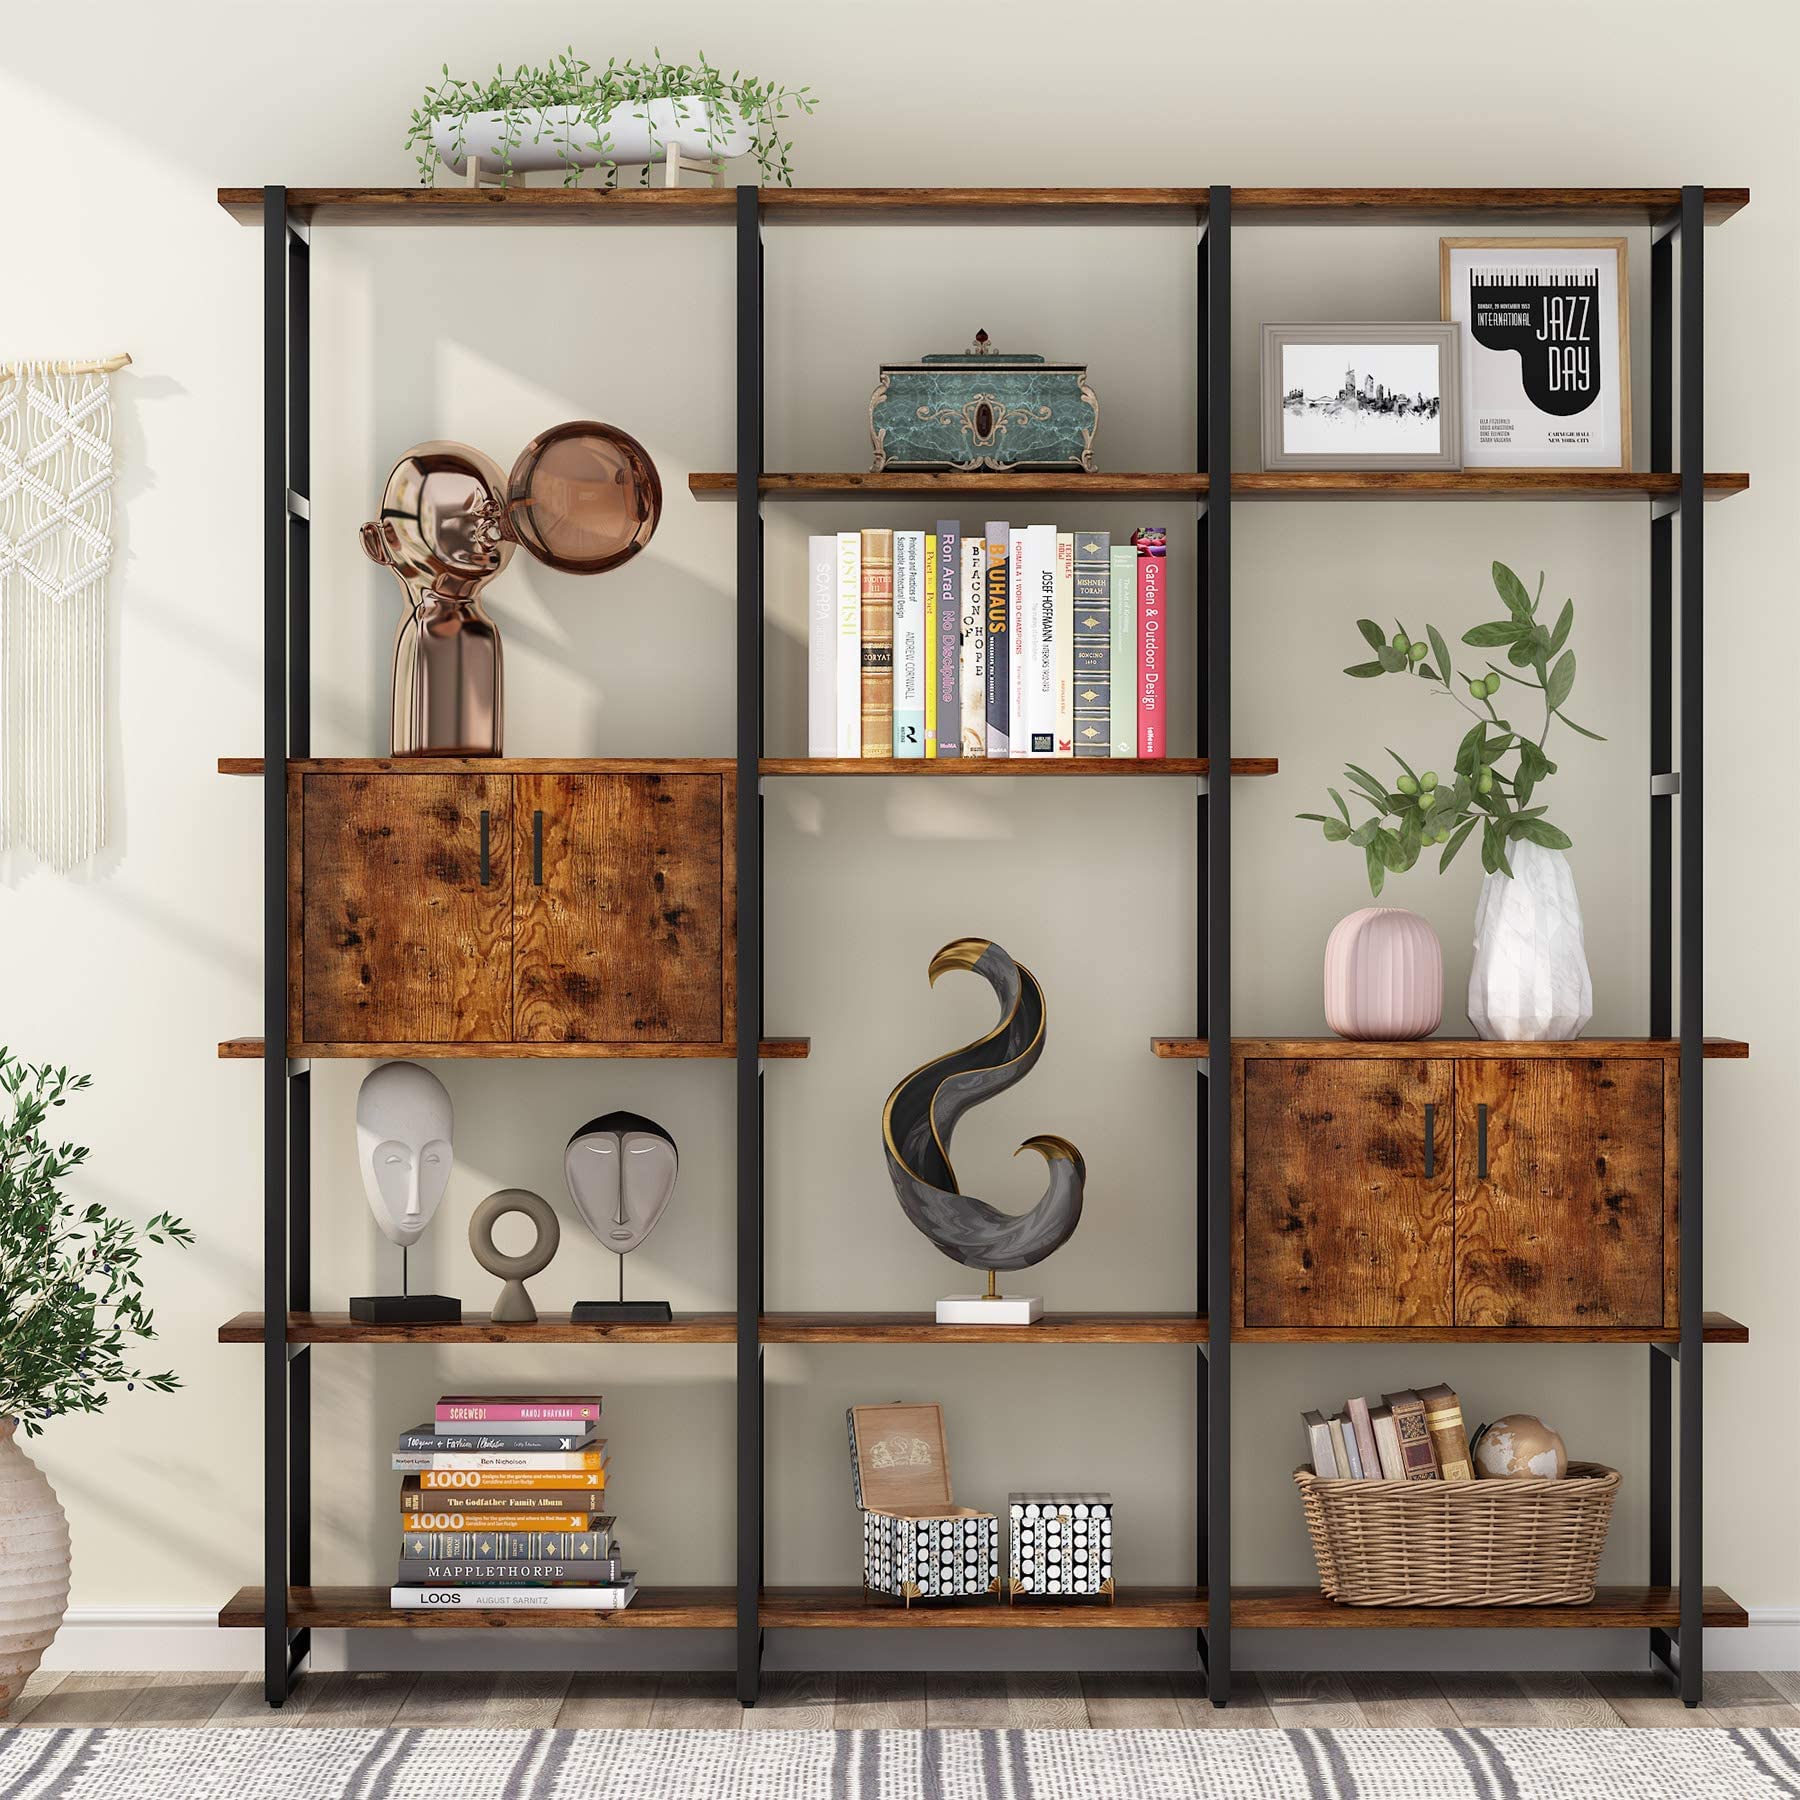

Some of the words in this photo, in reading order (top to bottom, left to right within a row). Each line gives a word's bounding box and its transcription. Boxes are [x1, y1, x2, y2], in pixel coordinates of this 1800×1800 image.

[1477, 312, 1531, 327] INTERNATIONAL
[1536, 296, 1591, 341] JAZZ
[1548, 346, 1590, 392] DAY
[897, 536, 906, 565] Sustainable
[942, 534, 955, 563] Ron
[841, 539, 858, 588] LOST
[908, 561, 917, 571] and
[815, 563, 831, 621] SCARPA
[897, 566, 906, 599] Architectural
[908, 572, 918, 596] Practices
[942, 567, 955, 601] Arad
[988, 543, 1006, 634] BAUHAUS
[1041, 570, 1053, 594] JOSEF
[1145, 564, 1159, 605] Garden
[895, 600, 906, 619] Design
[942, 610, 955, 631] No
[1041, 595, 1053, 642] HOFFMANN
[1145, 608, 1159, 617] &
[904, 631, 916, 661] ANDREW
[975, 626, 984, 677] HOPE
[1145, 620, 1159, 669] Outdoor
[904, 662, 916, 700] CORNWALL
[939, 634, 956, 703] Discipline
[1141, 673, 1159, 711] Design
[449, 1407, 487, 1419] SCREWED!
[426, 1471, 481, 1488] 1000
[447, 1498, 464, 1506] The
[465, 1498, 507, 1506] Godfather
[509, 1498, 536, 1507] Family
[537, 1498, 563, 1506] Album
[410, 1513, 464, 1529] 1000
[428, 1566, 565, 1577] MAPPLETHORPE
[420, 1593, 461, 1604] LOOS
[476, 1596, 511, 1604] AUGUST
[512, 1596, 548, 1605] SARNITZ
